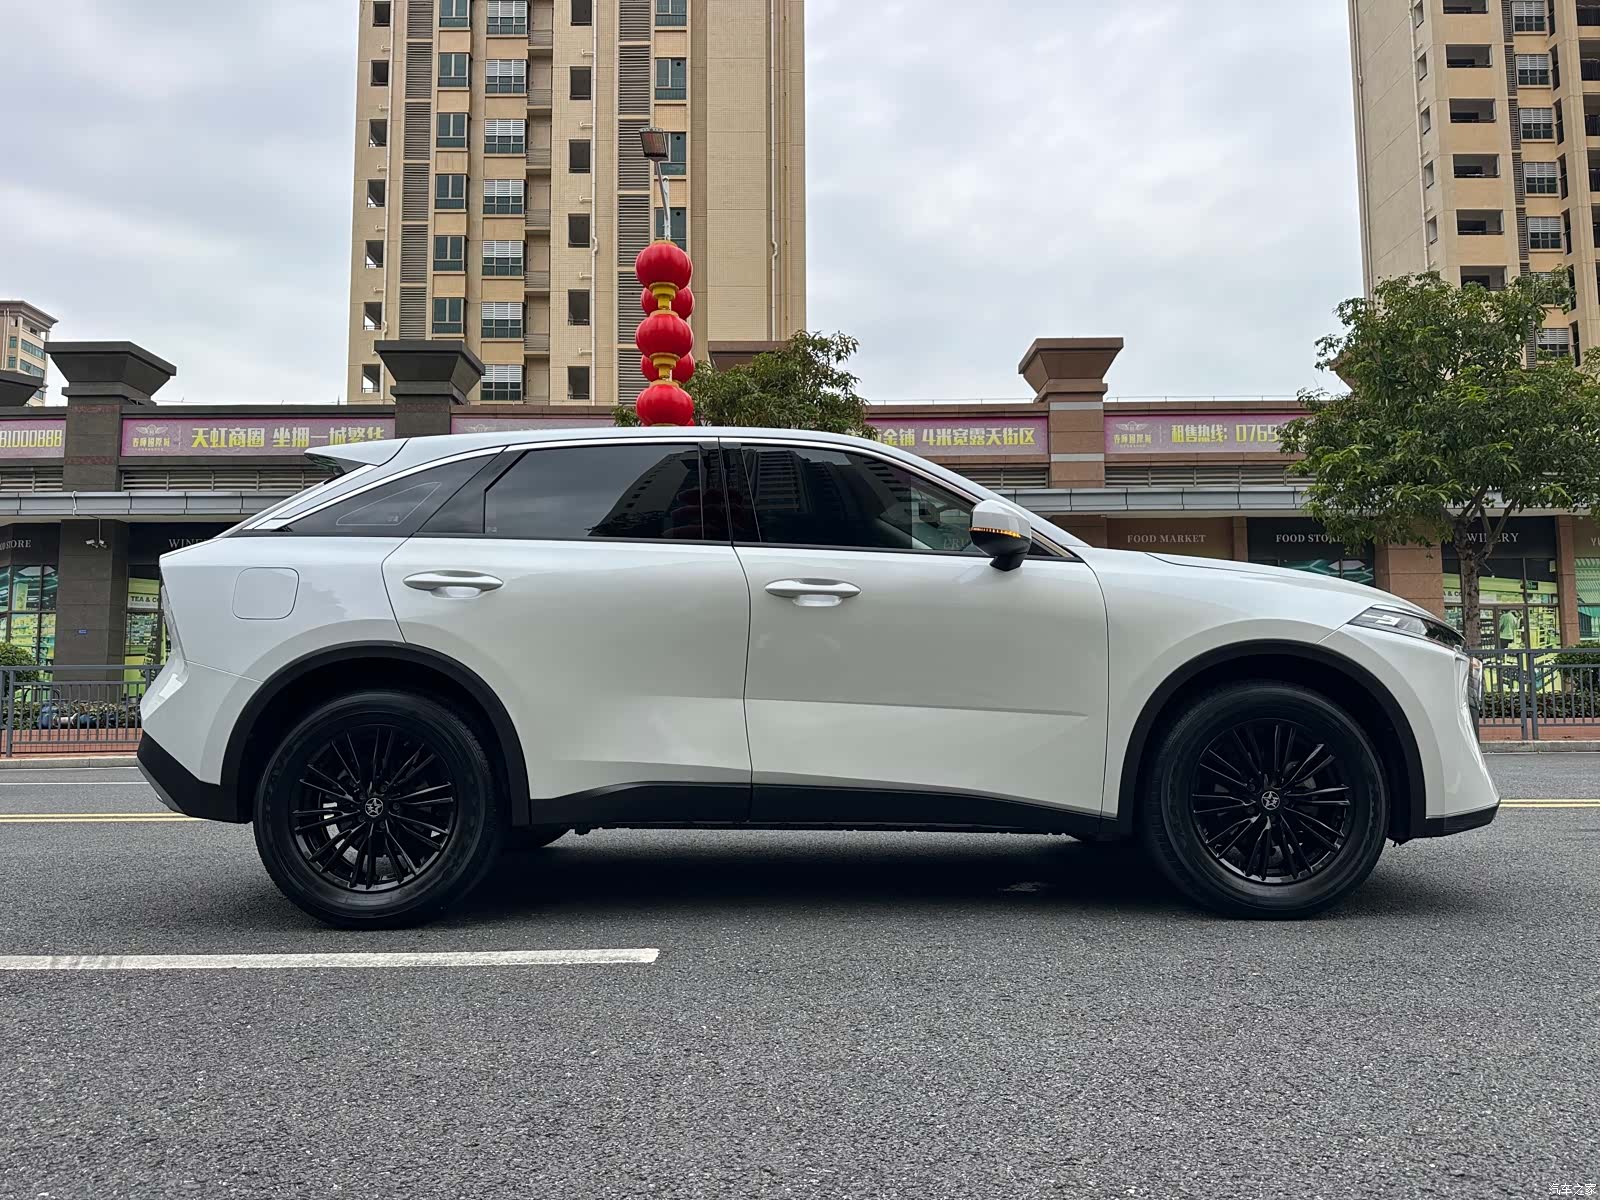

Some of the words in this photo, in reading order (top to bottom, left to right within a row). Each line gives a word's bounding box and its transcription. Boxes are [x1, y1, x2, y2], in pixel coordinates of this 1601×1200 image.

[191, 427, 265, 448] 天虹商圈
[921, 427, 1036, 446] 4米宽露天街区
[1127, 534, 1157, 543] FOOD
[1159, 534, 1207, 543] MARKET
[1276, 533, 1305, 543] FOOD
[131, 595, 144, 603] TEA
